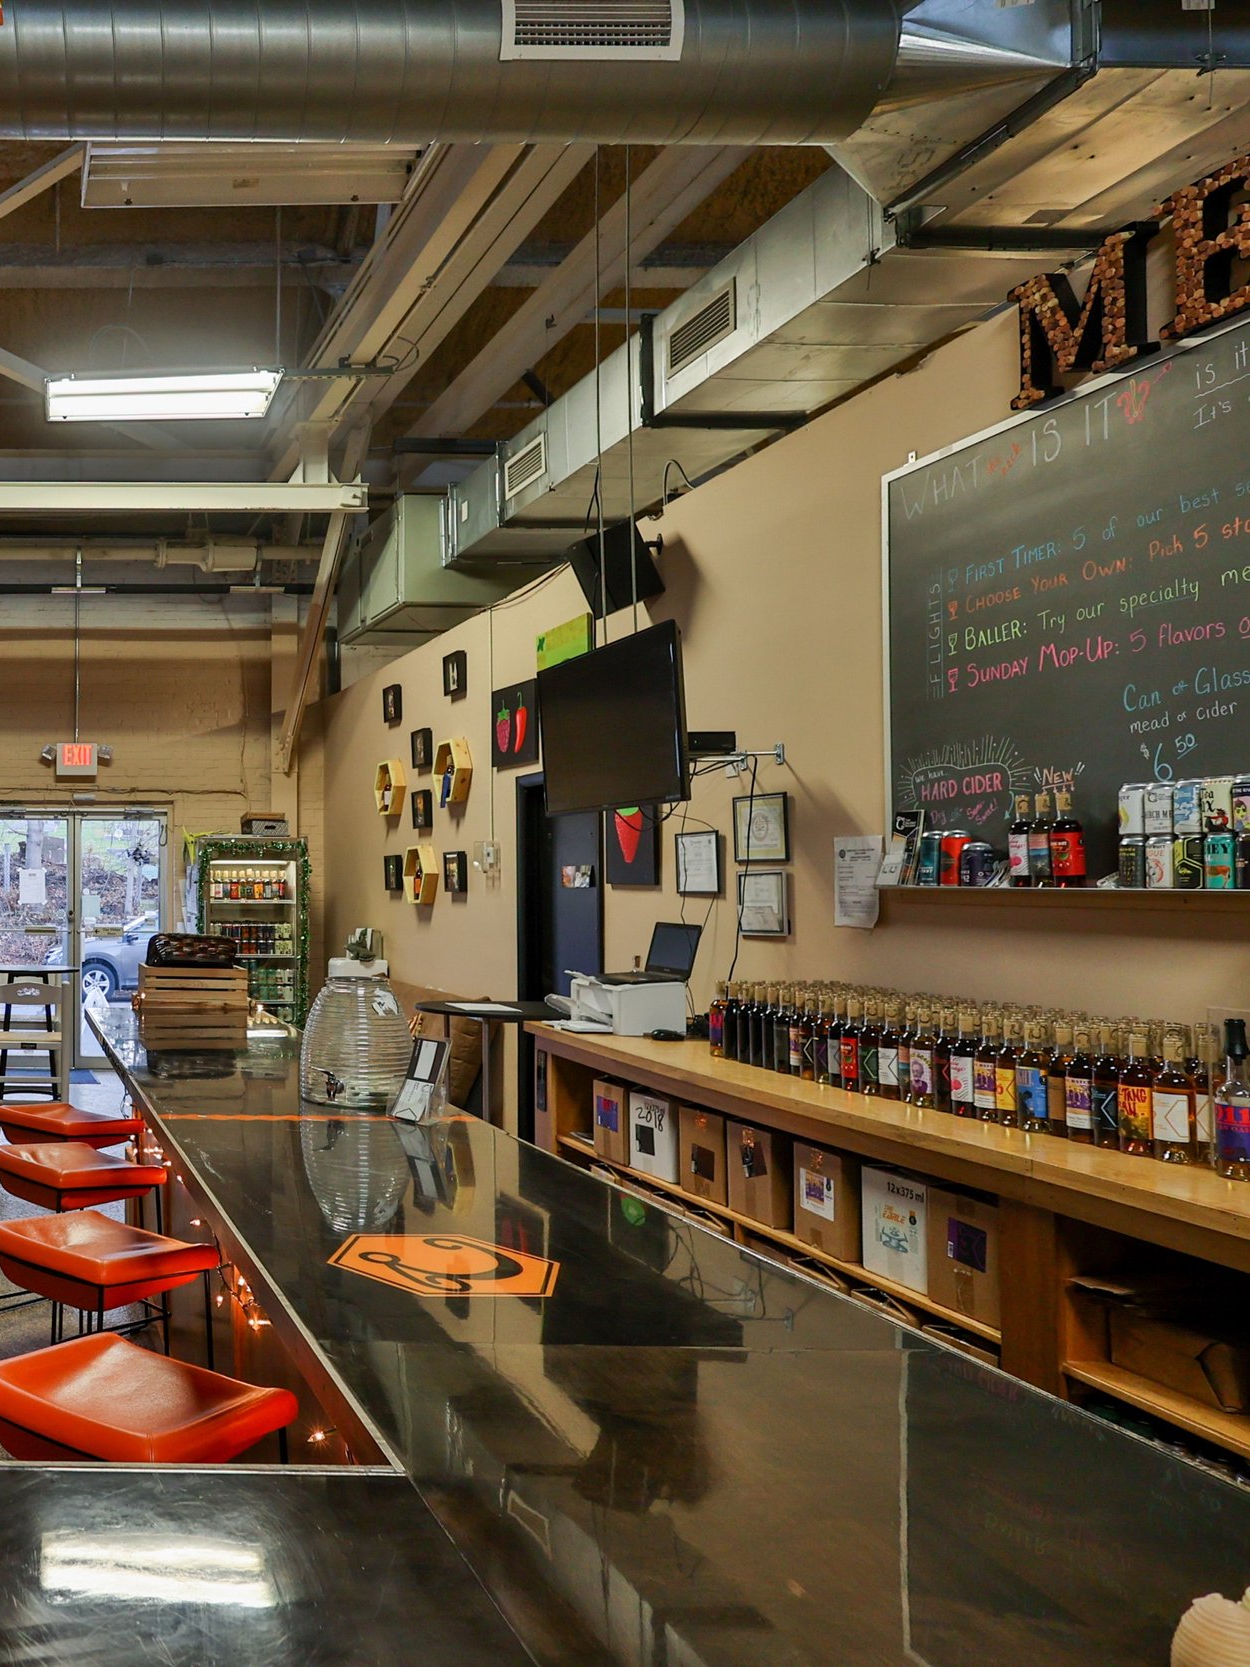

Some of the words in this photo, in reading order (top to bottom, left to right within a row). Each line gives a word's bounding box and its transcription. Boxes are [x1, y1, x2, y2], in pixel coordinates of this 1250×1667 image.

[1193, 400, 1232, 430] It's
[900, 454, 983, 520] WHAT
[1032, 418, 1062, 467] IS
[965, 558, 1006, 585] FIRST
[1011, 541, 1062, 569] TIMER:
[1072, 525, 1086, 551] 5
[1102, 516, 1118, 541] of
[1136, 508, 1163, 528] our
[1179, 488, 1220, 514] best
[966, 586, 1022, 613] CHOOSE
[1030, 573, 1069, 596] YOUR
[1082, 557, 1134, 581] OWN:
[1149, 534, 1184, 561] Pick
[1193, 523, 1209, 550] 5
[929, 583, 941, 683] FLIGHTS
[965, 619, 1028, 651] BALLER:
[1037, 609, 1066, 634] Try
[1076, 602, 1105, 622] our
[1119, 577, 1200, 618] specialty
[967, 656, 1029, 688] SUNDAY
[1039, 635, 1121, 673] MOP-UP:
[1130, 628, 1147, 653] 5
[1158, 621, 1226, 648] flavors
[1123, 684, 1162, 712] Can
[1130, 711, 1170, 734] mead
[1177, 711, 1188, 722] or
[1196, 700, 1238, 721] cider
[62, 744, 93, 767] EXIT
[920, 779, 958, 802] HARD
[963, 772, 1003, 796] CIDER
[1041, 766, 1075, 787] NEW
[635, 1106, 664, 1132] 2018
